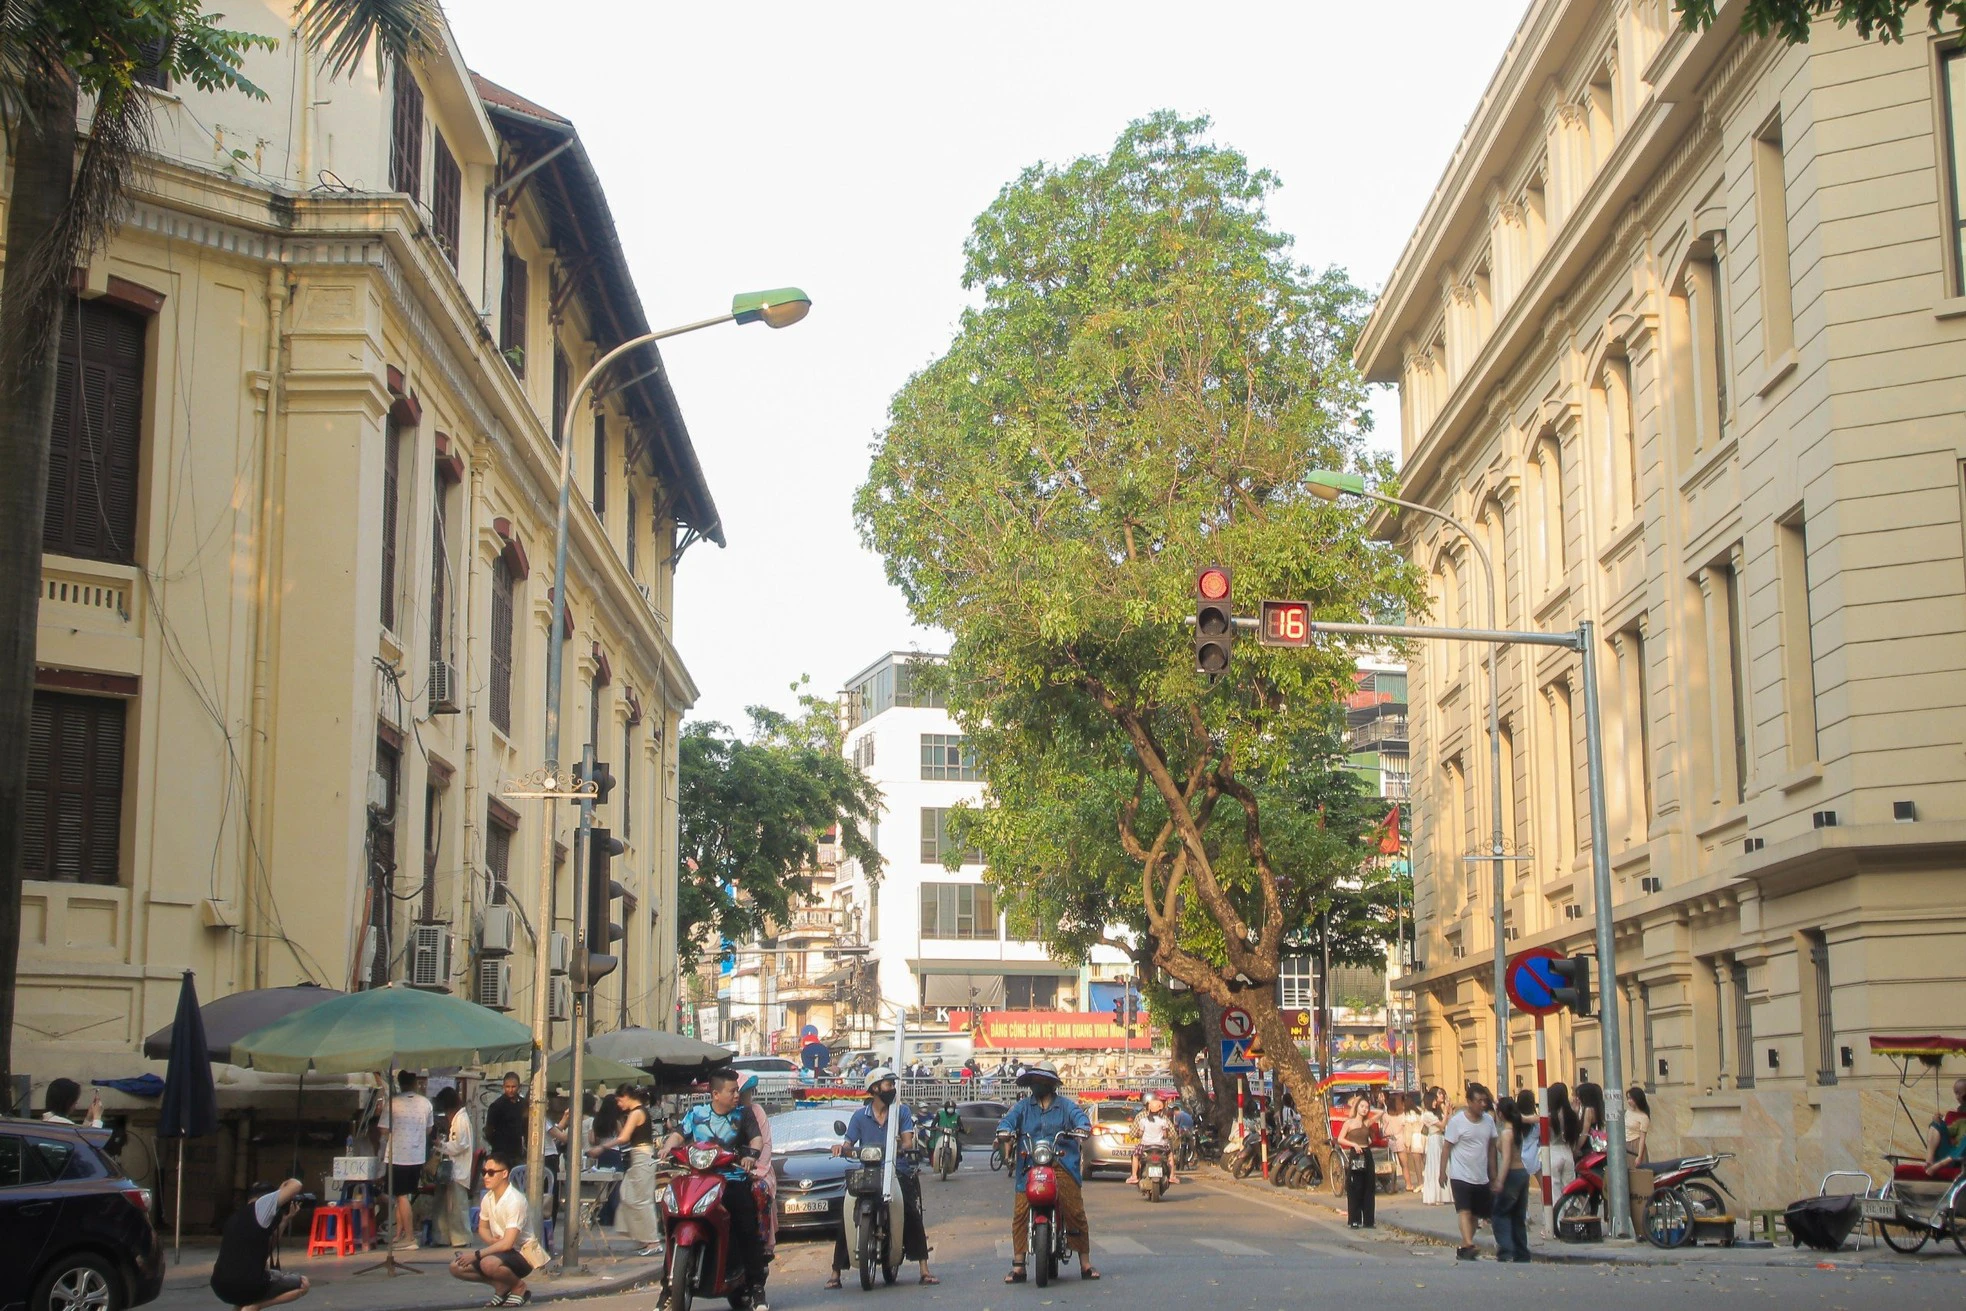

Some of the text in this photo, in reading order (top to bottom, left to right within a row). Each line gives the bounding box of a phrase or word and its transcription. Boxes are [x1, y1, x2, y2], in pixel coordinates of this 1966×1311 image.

[1279, 607, 1304, 639] 16
[1009, 1021, 1027, 1040] CỘNG
[1027, 1018, 1041, 1038] SẢN
[1042, 1021, 1055, 1040] VIỆT
[1056, 1023, 1071, 1038] NAM
[1072, 1023, 1093, 1039] QUANG
[1094, 1023, 1109, 1038] VINH
